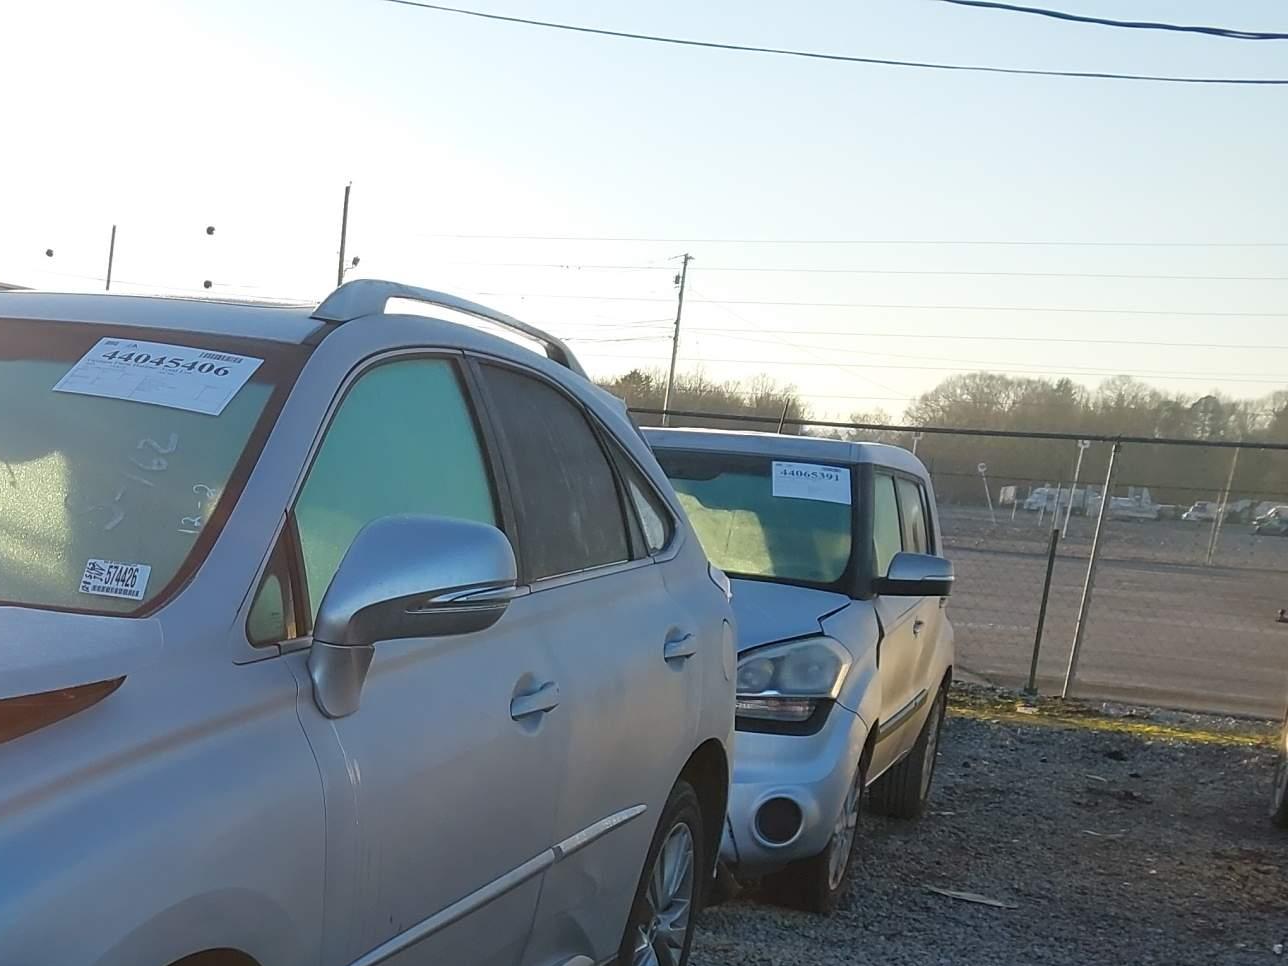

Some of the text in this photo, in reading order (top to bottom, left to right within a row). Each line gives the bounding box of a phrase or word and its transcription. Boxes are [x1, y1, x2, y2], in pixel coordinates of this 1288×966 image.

[102, 350, 231, 377] 44045406
[780, 469, 839, 482] 44065391
[105, 565, 139, 588] 574426
